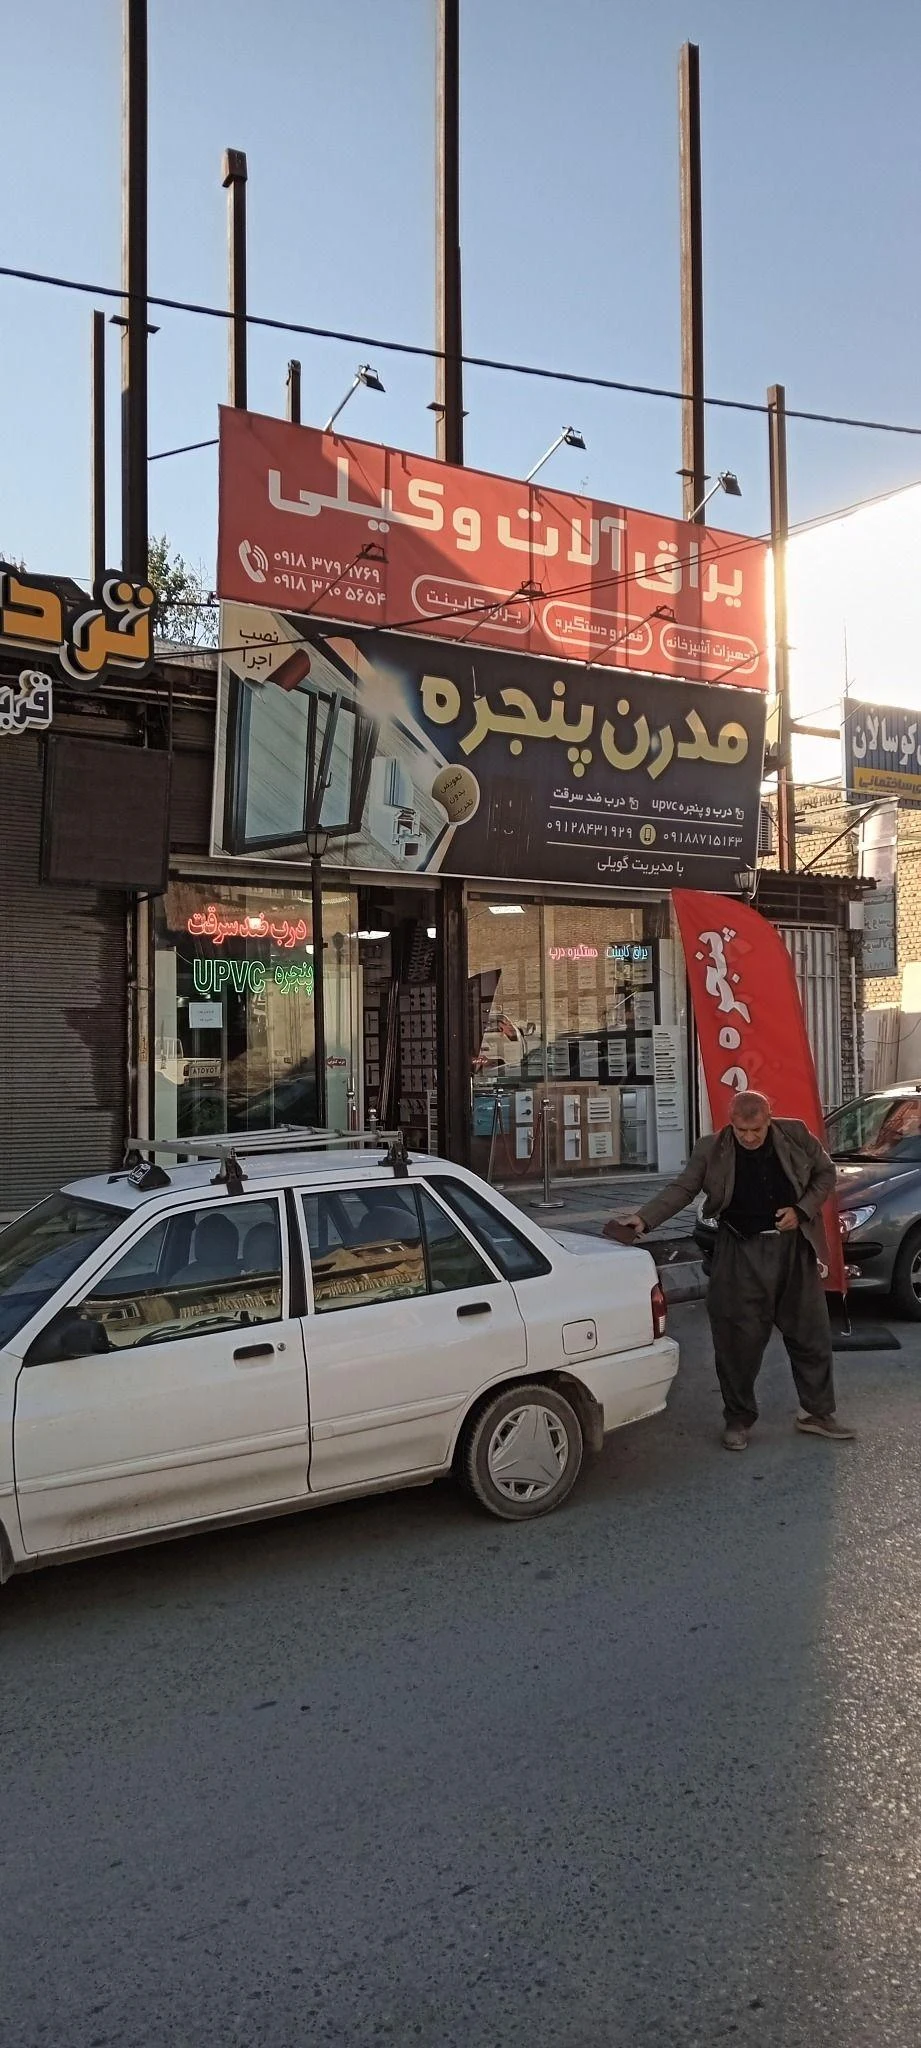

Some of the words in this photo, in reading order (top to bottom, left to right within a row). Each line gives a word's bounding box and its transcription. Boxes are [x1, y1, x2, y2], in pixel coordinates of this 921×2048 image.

[268, 457, 481, 552] وکیلی
[497, 507, 627, 571] آلات
[274, 551, 306, 568] ۰۹۱۸
[311, 556, 341, 575] ۳۷۹
[634, 539, 743, 608] یراق
[274, 574, 306, 591] ۰۹۱۸
[345, 587, 386, 605] ۵۶۵۴
[427, 590, 485, 612] کابینت
[239, 627, 279, 644] نصب
[555, 616, 607, 635] دستگیره
[666, 636, 711, 657] آشپزخانه
[242, 648, 272, 669] اجرا
[419, 675, 595, 778] پنجره
[600, 699, 749, 780] مدرن
[553, 787, 584, 801] سرقت
[586, 792, 602, 804] ضد
[604, 795, 625, 808] درب
[652, 799, 678, 812] upvc
[679, 803, 705, 818] پنجره
[705, 808, 710, 817] و
[712, 807, 732, 818] درب
[547, 820, 632, 839] ۰۹۱۲۸۴۳۱۹۲۹
[663, 831, 743, 847] ۰۹۱۸۸۷۱۵۱۴۳
[632, 859, 674, 876] مدیریت
[676, 861, 684, 877] با
[188, 905, 239, 944] سرقت
[240, 912, 269, 937] ضد
[271, 918, 307, 948] درب
[193, 959, 266, 993] UPVC
[274, 962, 314, 996] پنجره
[695, 927, 751, 1050] پنجره
